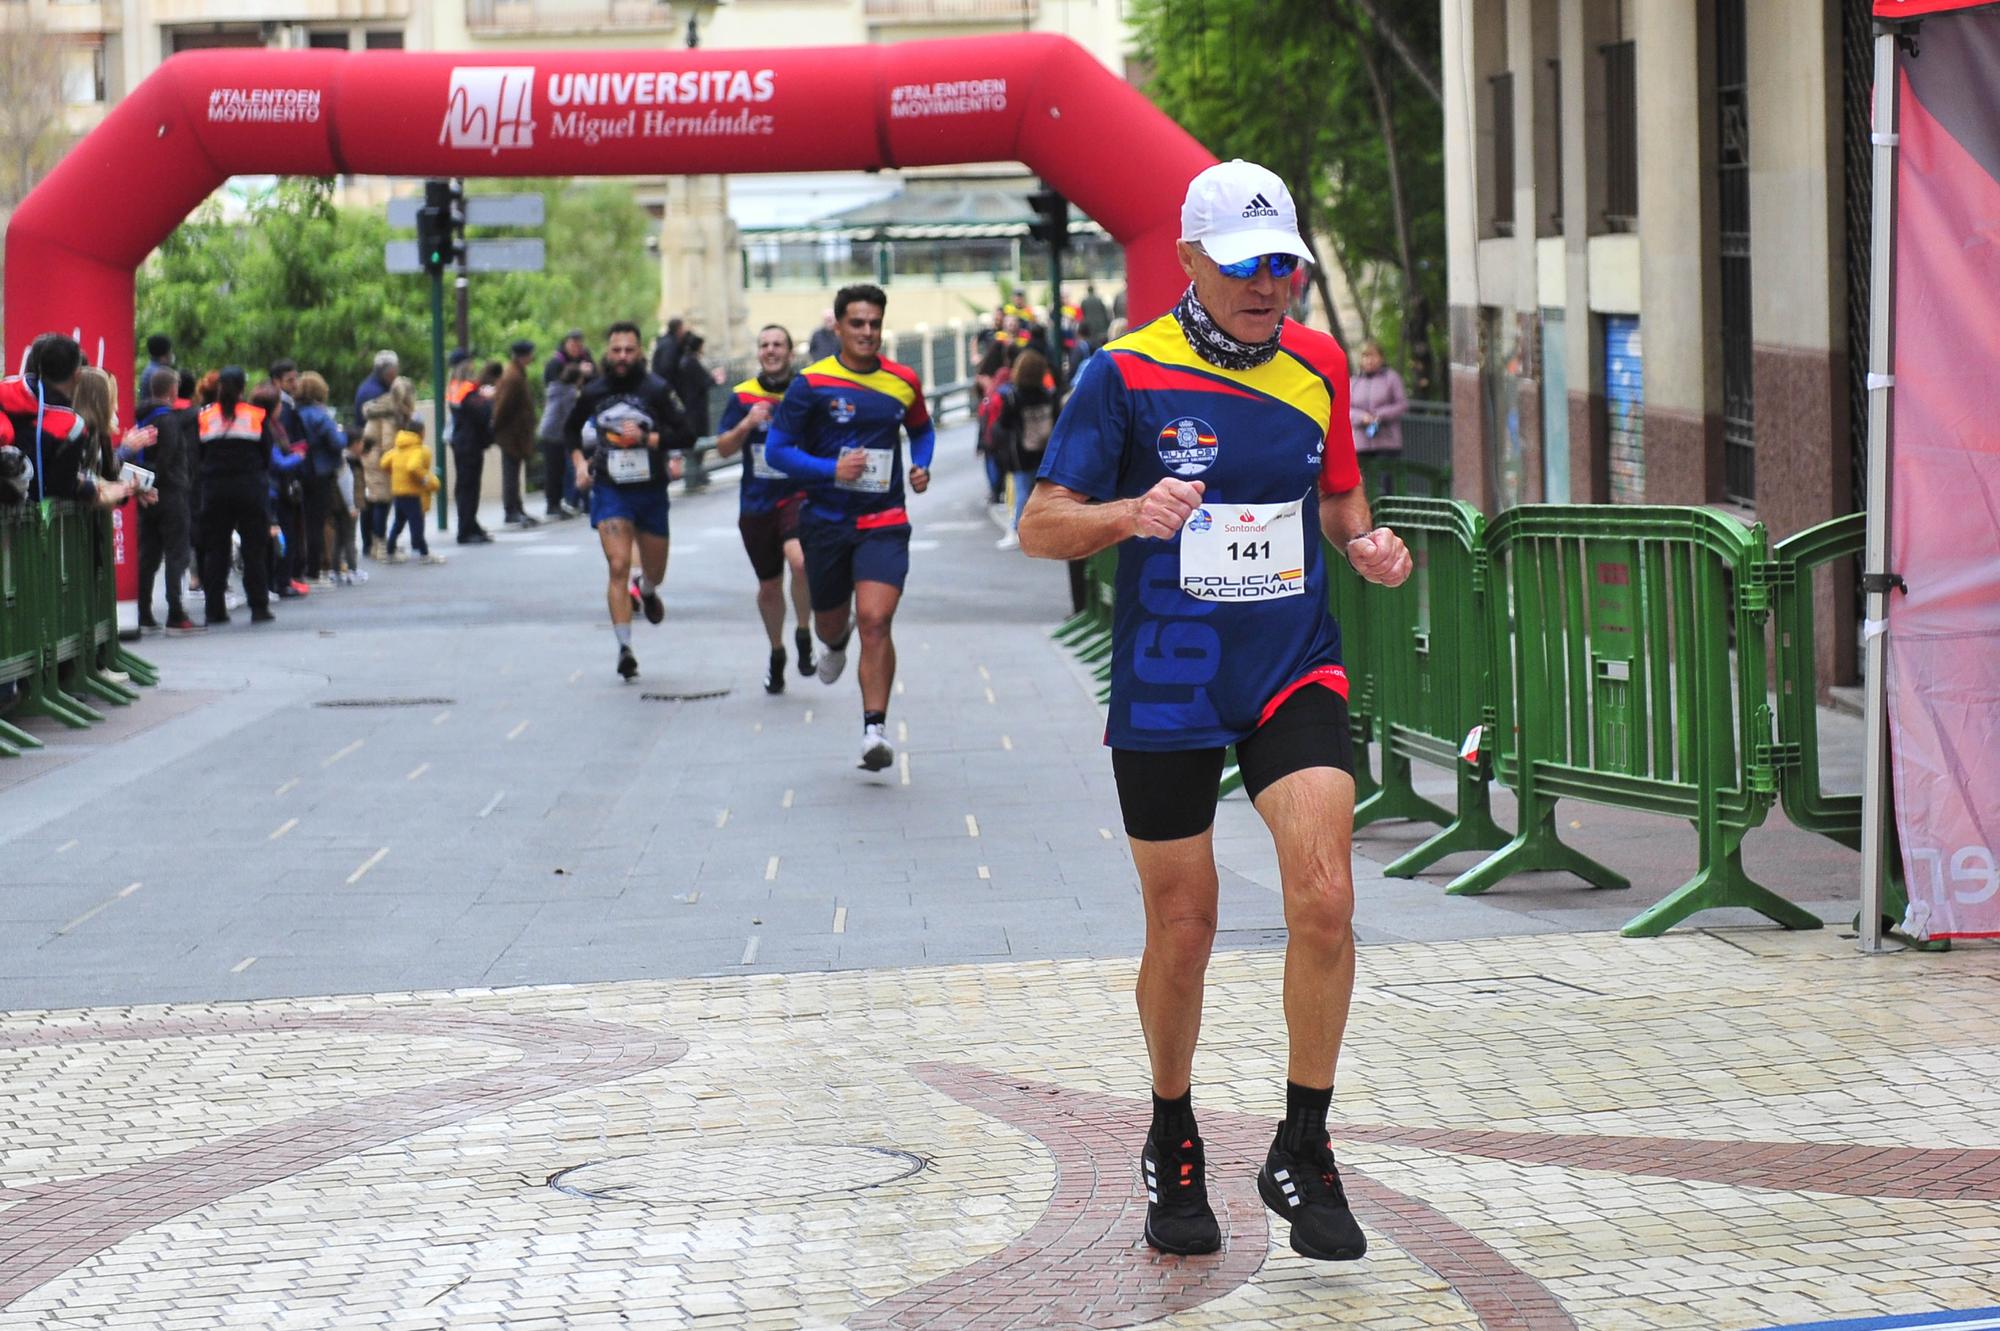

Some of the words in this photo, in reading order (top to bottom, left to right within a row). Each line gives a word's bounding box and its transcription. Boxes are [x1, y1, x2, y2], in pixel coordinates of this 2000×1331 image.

[209, 88, 321, 105] #TALENTOEN
[547, 69, 775, 106] UNIVERSITAS
[891, 78, 1007, 101] #TALENTOEN
[207, 103, 320, 122] MOVIMIENTO
[890, 94, 1008, 119] MOVIMIENTO
[549, 109, 635, 143] Miguel
[643, 108, 775, 137] Hernández
[1241, 207, 1279, 218] adidas
[1224, 523, 1267, 533] Santande
[1227, 540, 1270, 561] 141
[1183, 581, 1299, 597] NACIONAL
[1184, 573, 1281, 586] POLICIA
